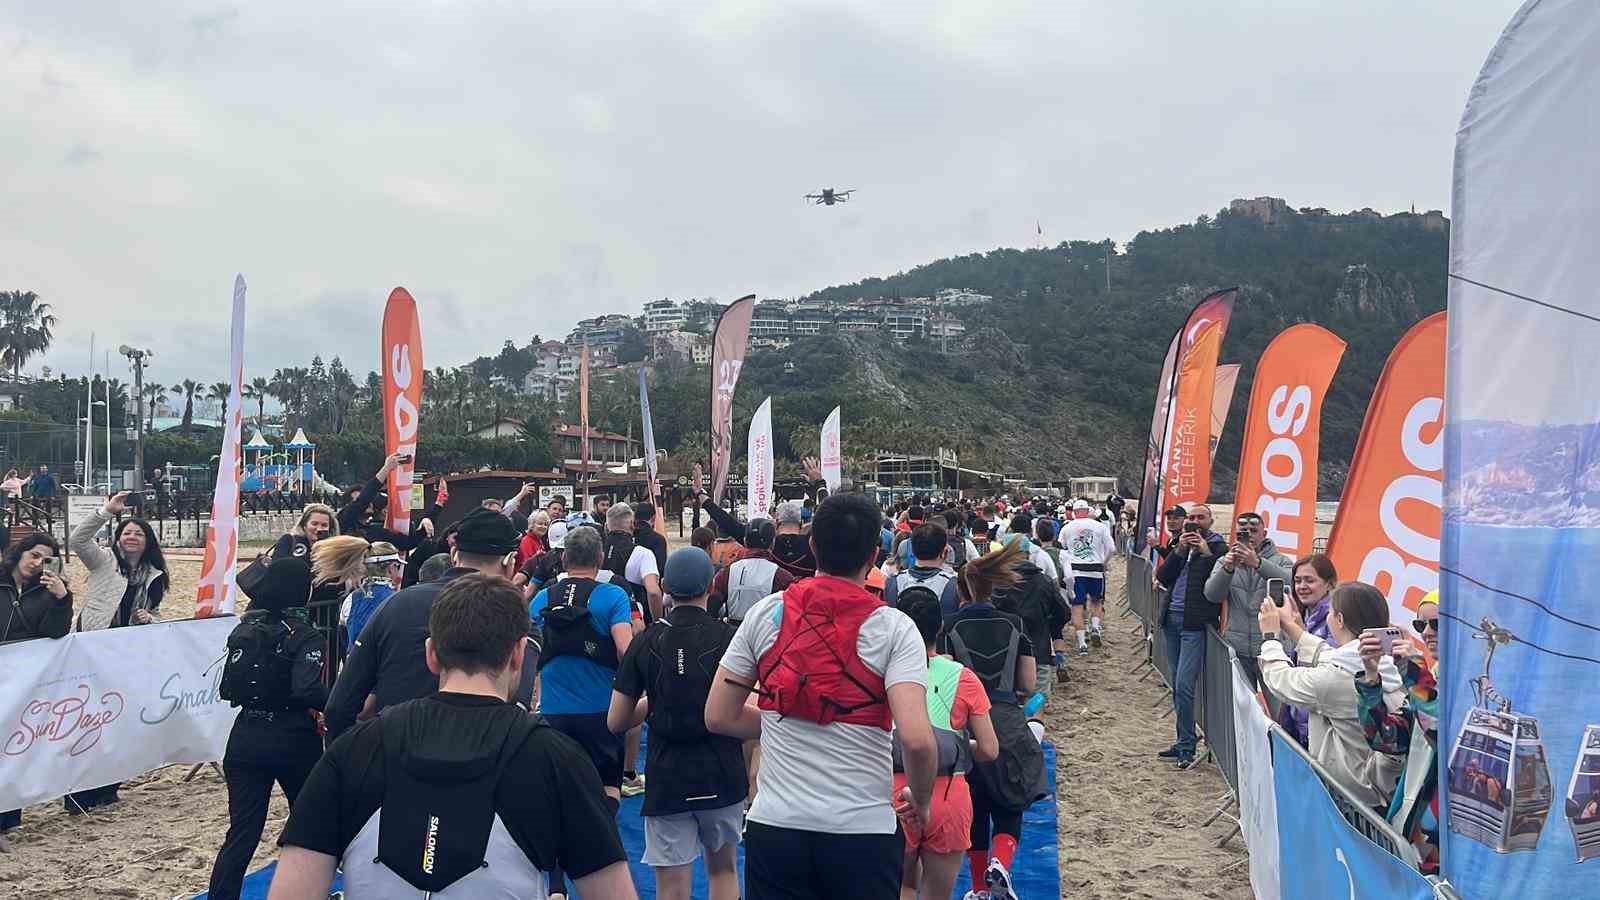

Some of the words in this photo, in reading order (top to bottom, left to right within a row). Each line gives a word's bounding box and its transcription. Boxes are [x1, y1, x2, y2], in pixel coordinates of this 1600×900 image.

[1169, 425, 1184, 497] ALANYA
[1253, 384, 1312, 559] ROS
[424, 816, 440, 875] SALOMON
